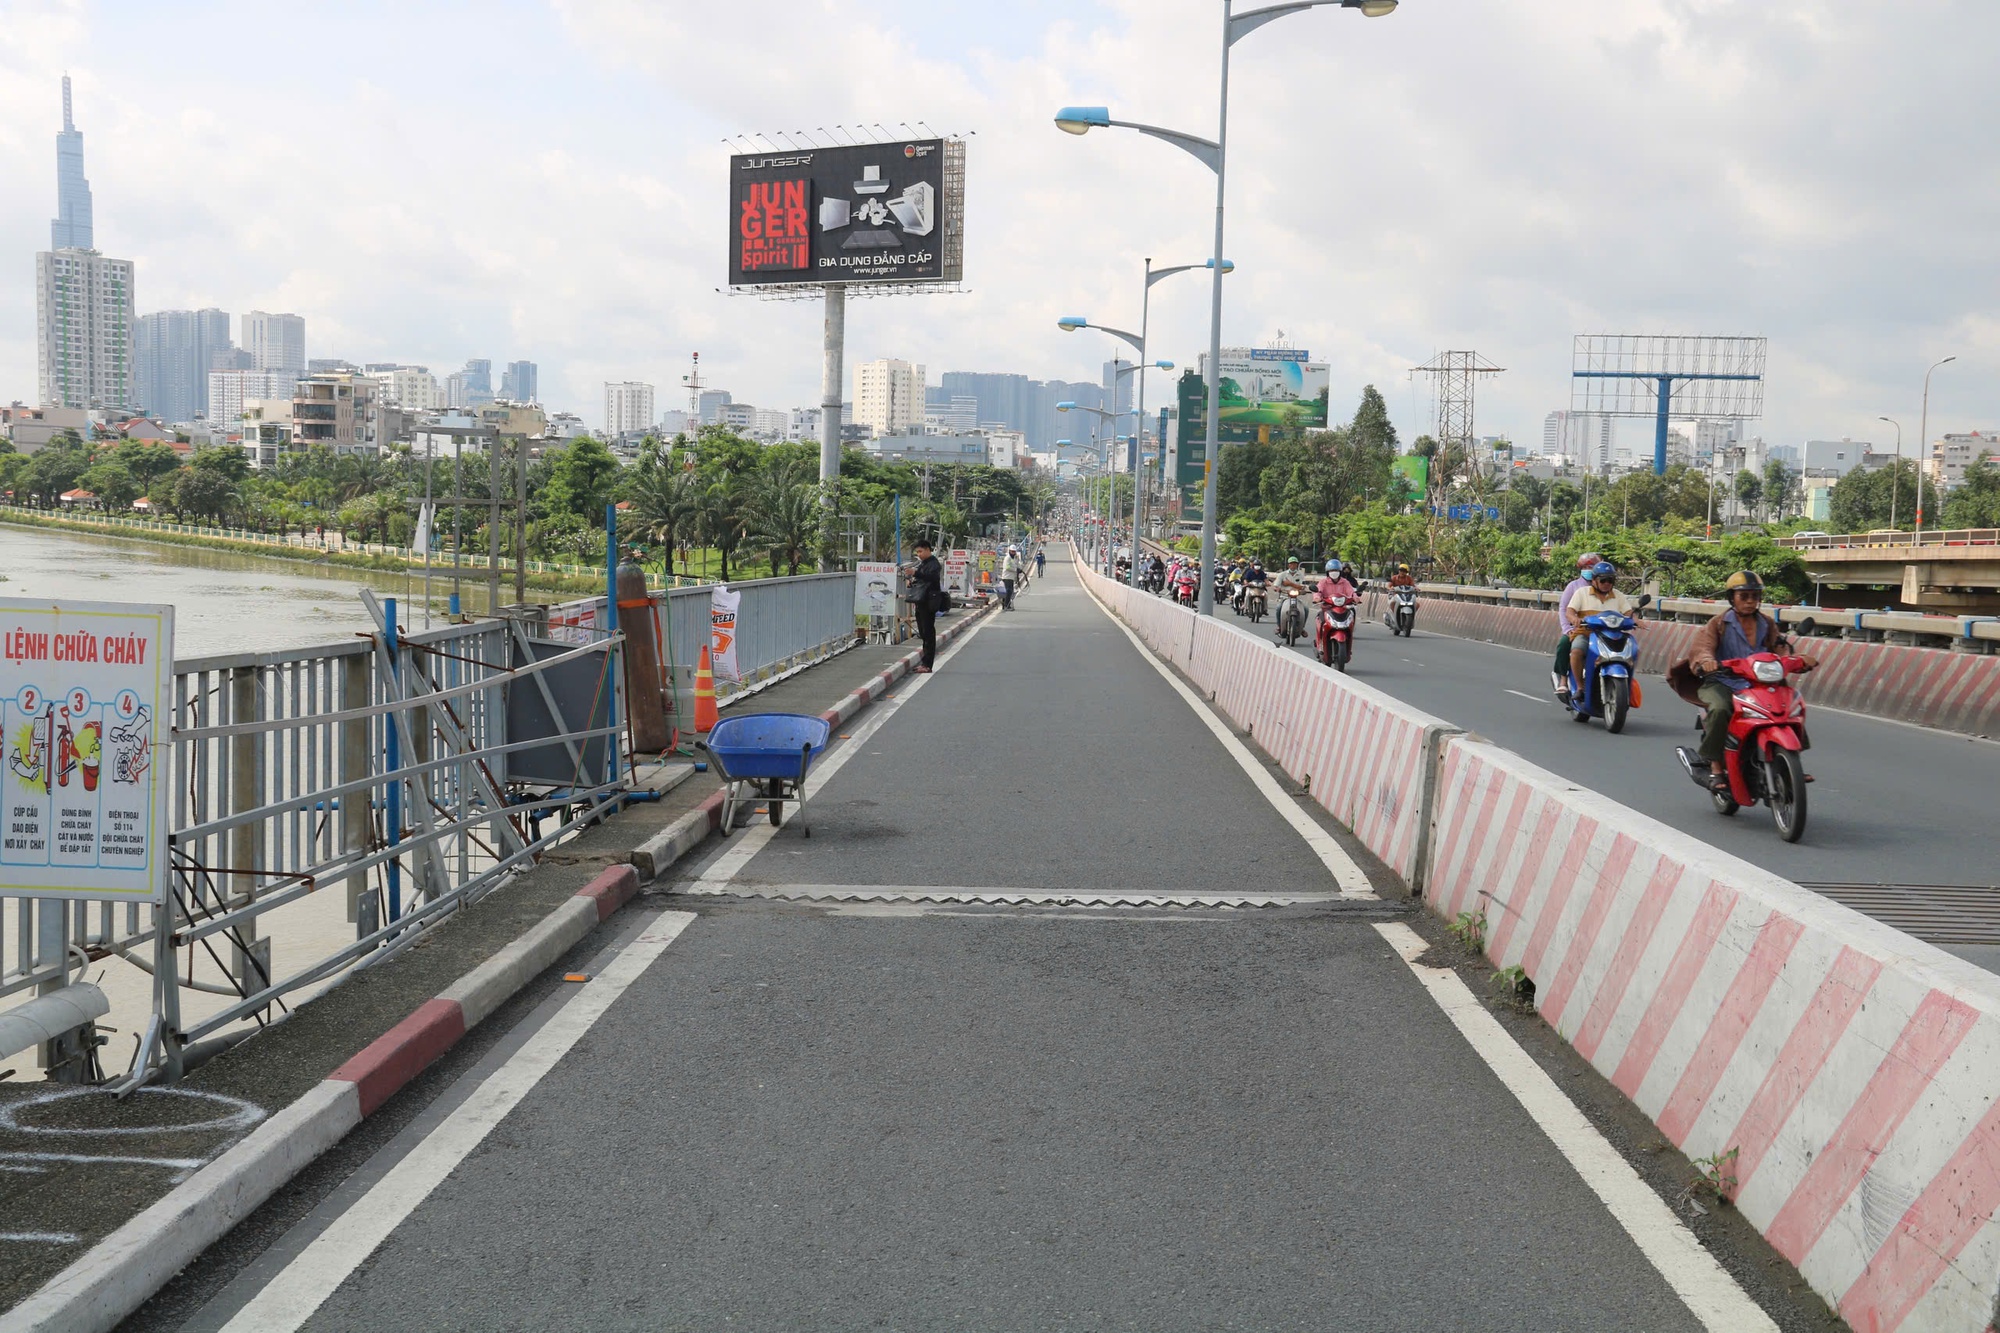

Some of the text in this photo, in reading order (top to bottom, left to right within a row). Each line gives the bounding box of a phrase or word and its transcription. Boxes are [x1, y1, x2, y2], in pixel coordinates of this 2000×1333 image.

[741, 155, 811, 170] JUNGER
[741, 179, 805, 210] JUN
[740, 208, 809, 239] GER
[742, 246, 789, 271] spirit
[818, 249, 933, 269] GIA DỤNG ĐẲNG CẤP
[853, 267, 898, 276] www.junger.vn
[5, 626, 147, 666] LỆNH CHỮA CHÁY
[24, 691, 35, 710] 2
[74, 693, 84, 712] 3
[122, 695, 132, 714] 4
[123, 823, 133, 831] 114
